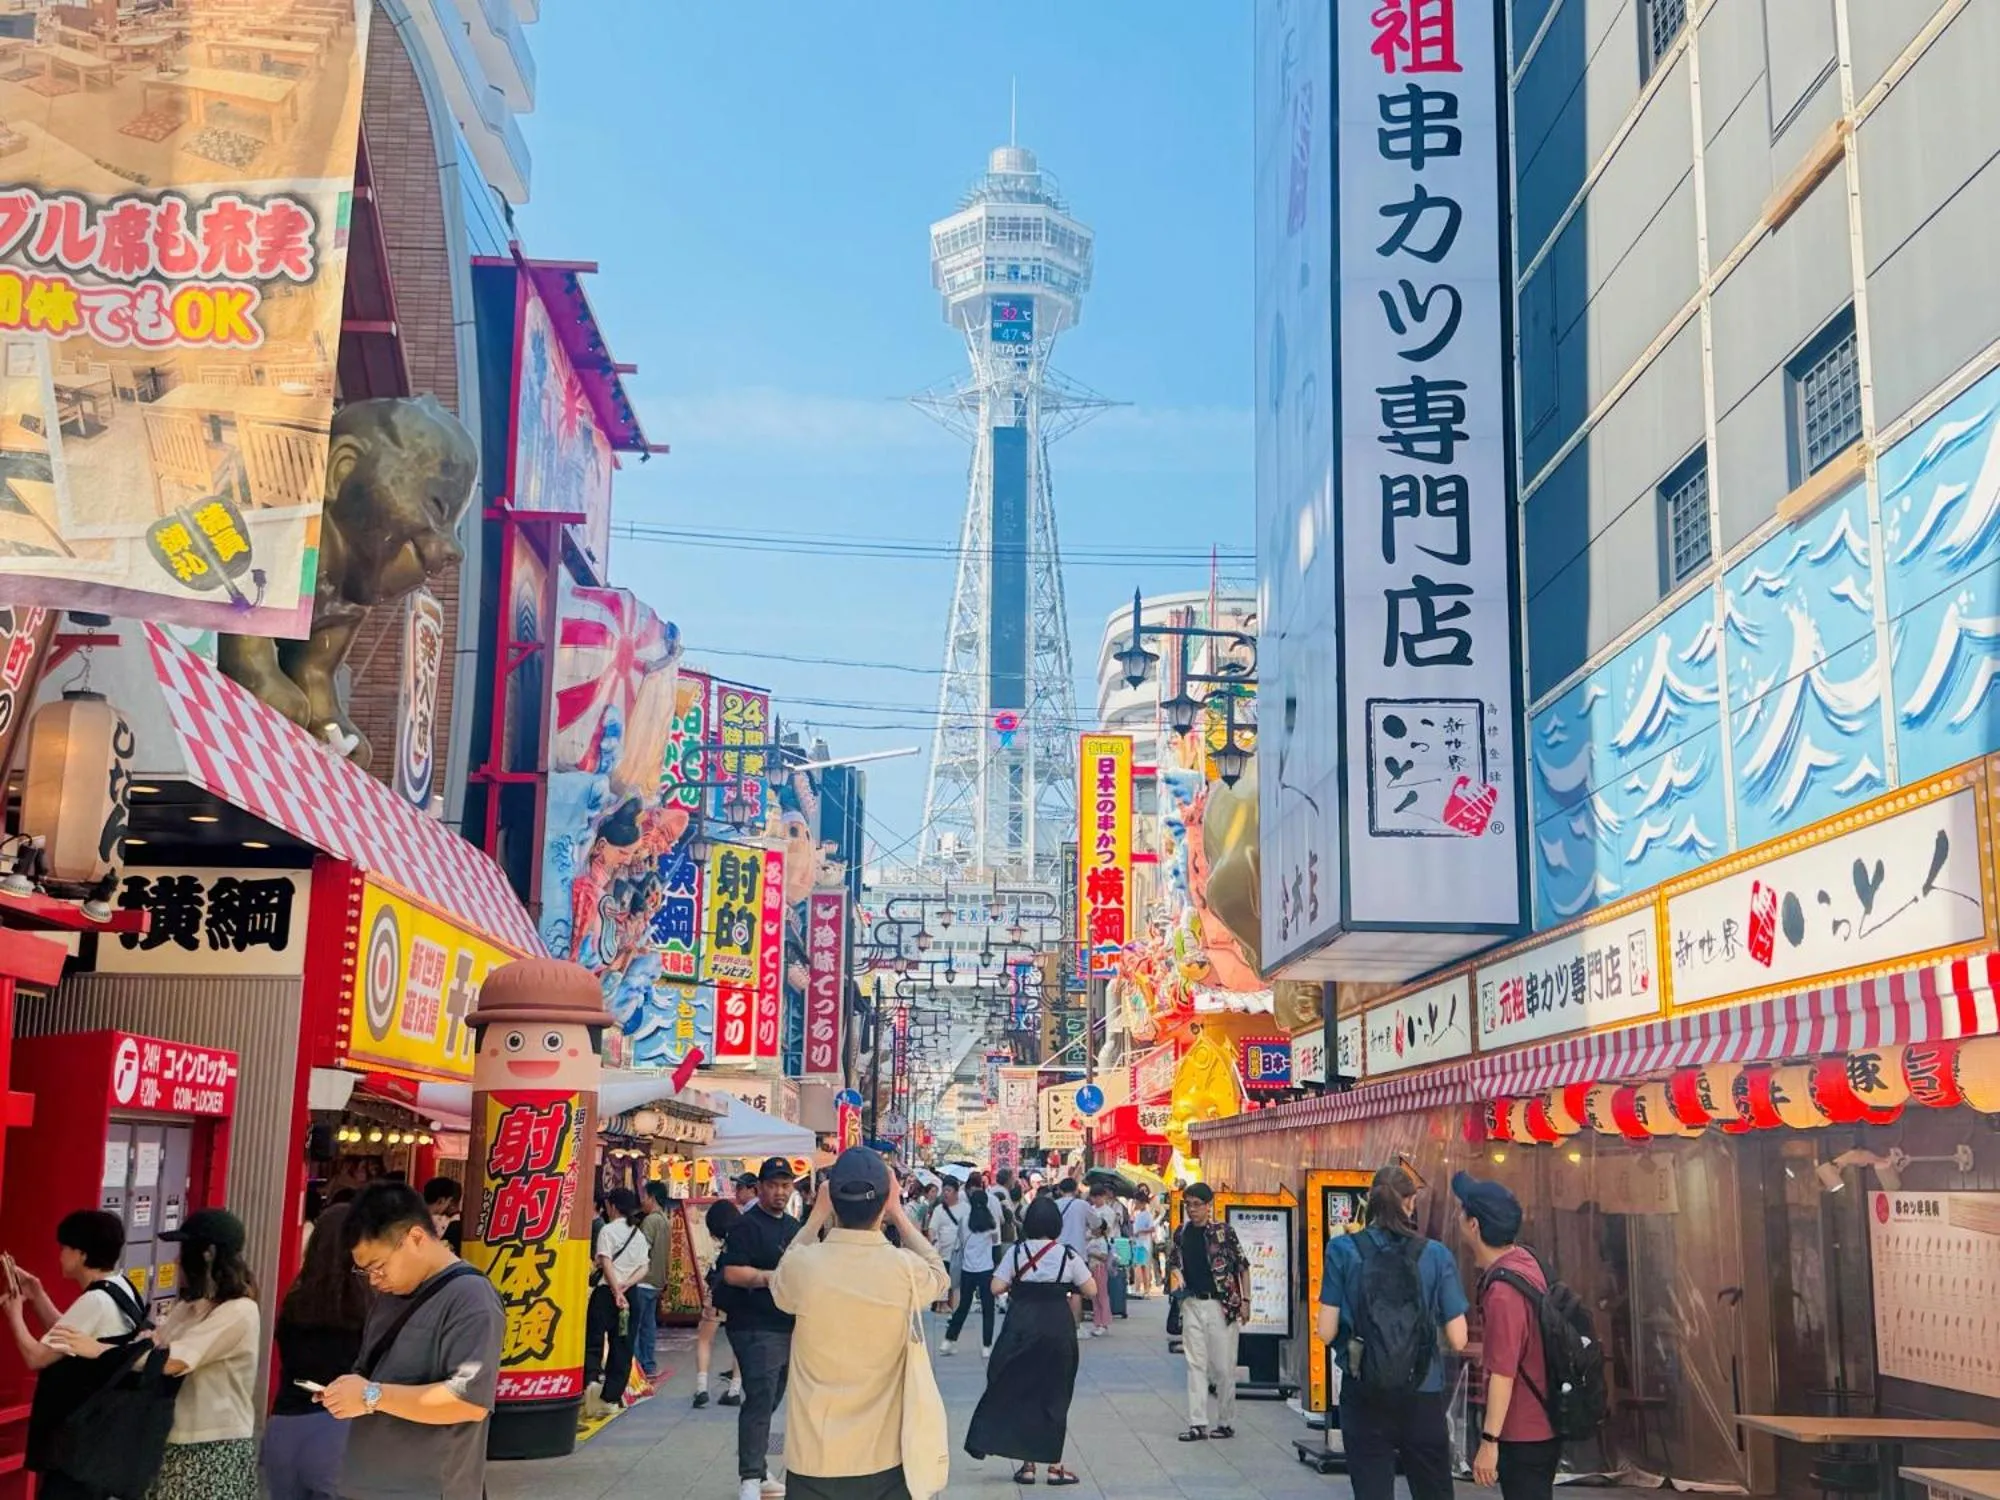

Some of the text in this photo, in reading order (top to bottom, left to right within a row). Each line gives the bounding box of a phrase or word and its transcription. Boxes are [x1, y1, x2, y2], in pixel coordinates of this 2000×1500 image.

[1001, 305, 1017, 320] 32
[1001, 328, 1018, 340] 47
[723, 694, 763, 727] 24
[1095, 757, 1117, 865] 日本一の串かつ
[118, 875, 296, 953] 横綱
[715, 850, 760, 956] 射的
[1086, 866, 1125, 947] 横綱
[1674, 917, 1745, 970] 新世界
[1499, 945, 1623, 1026] 元祖串カツ専門店
[141, 1042, 237, 1087] 24H コインロッカー
[1850, 1052, 1888, 1093] 豚
[172, 1086, 225, 1114] COIN-LOCKER
[496, 1373, 573, 1399] チャンピオン
